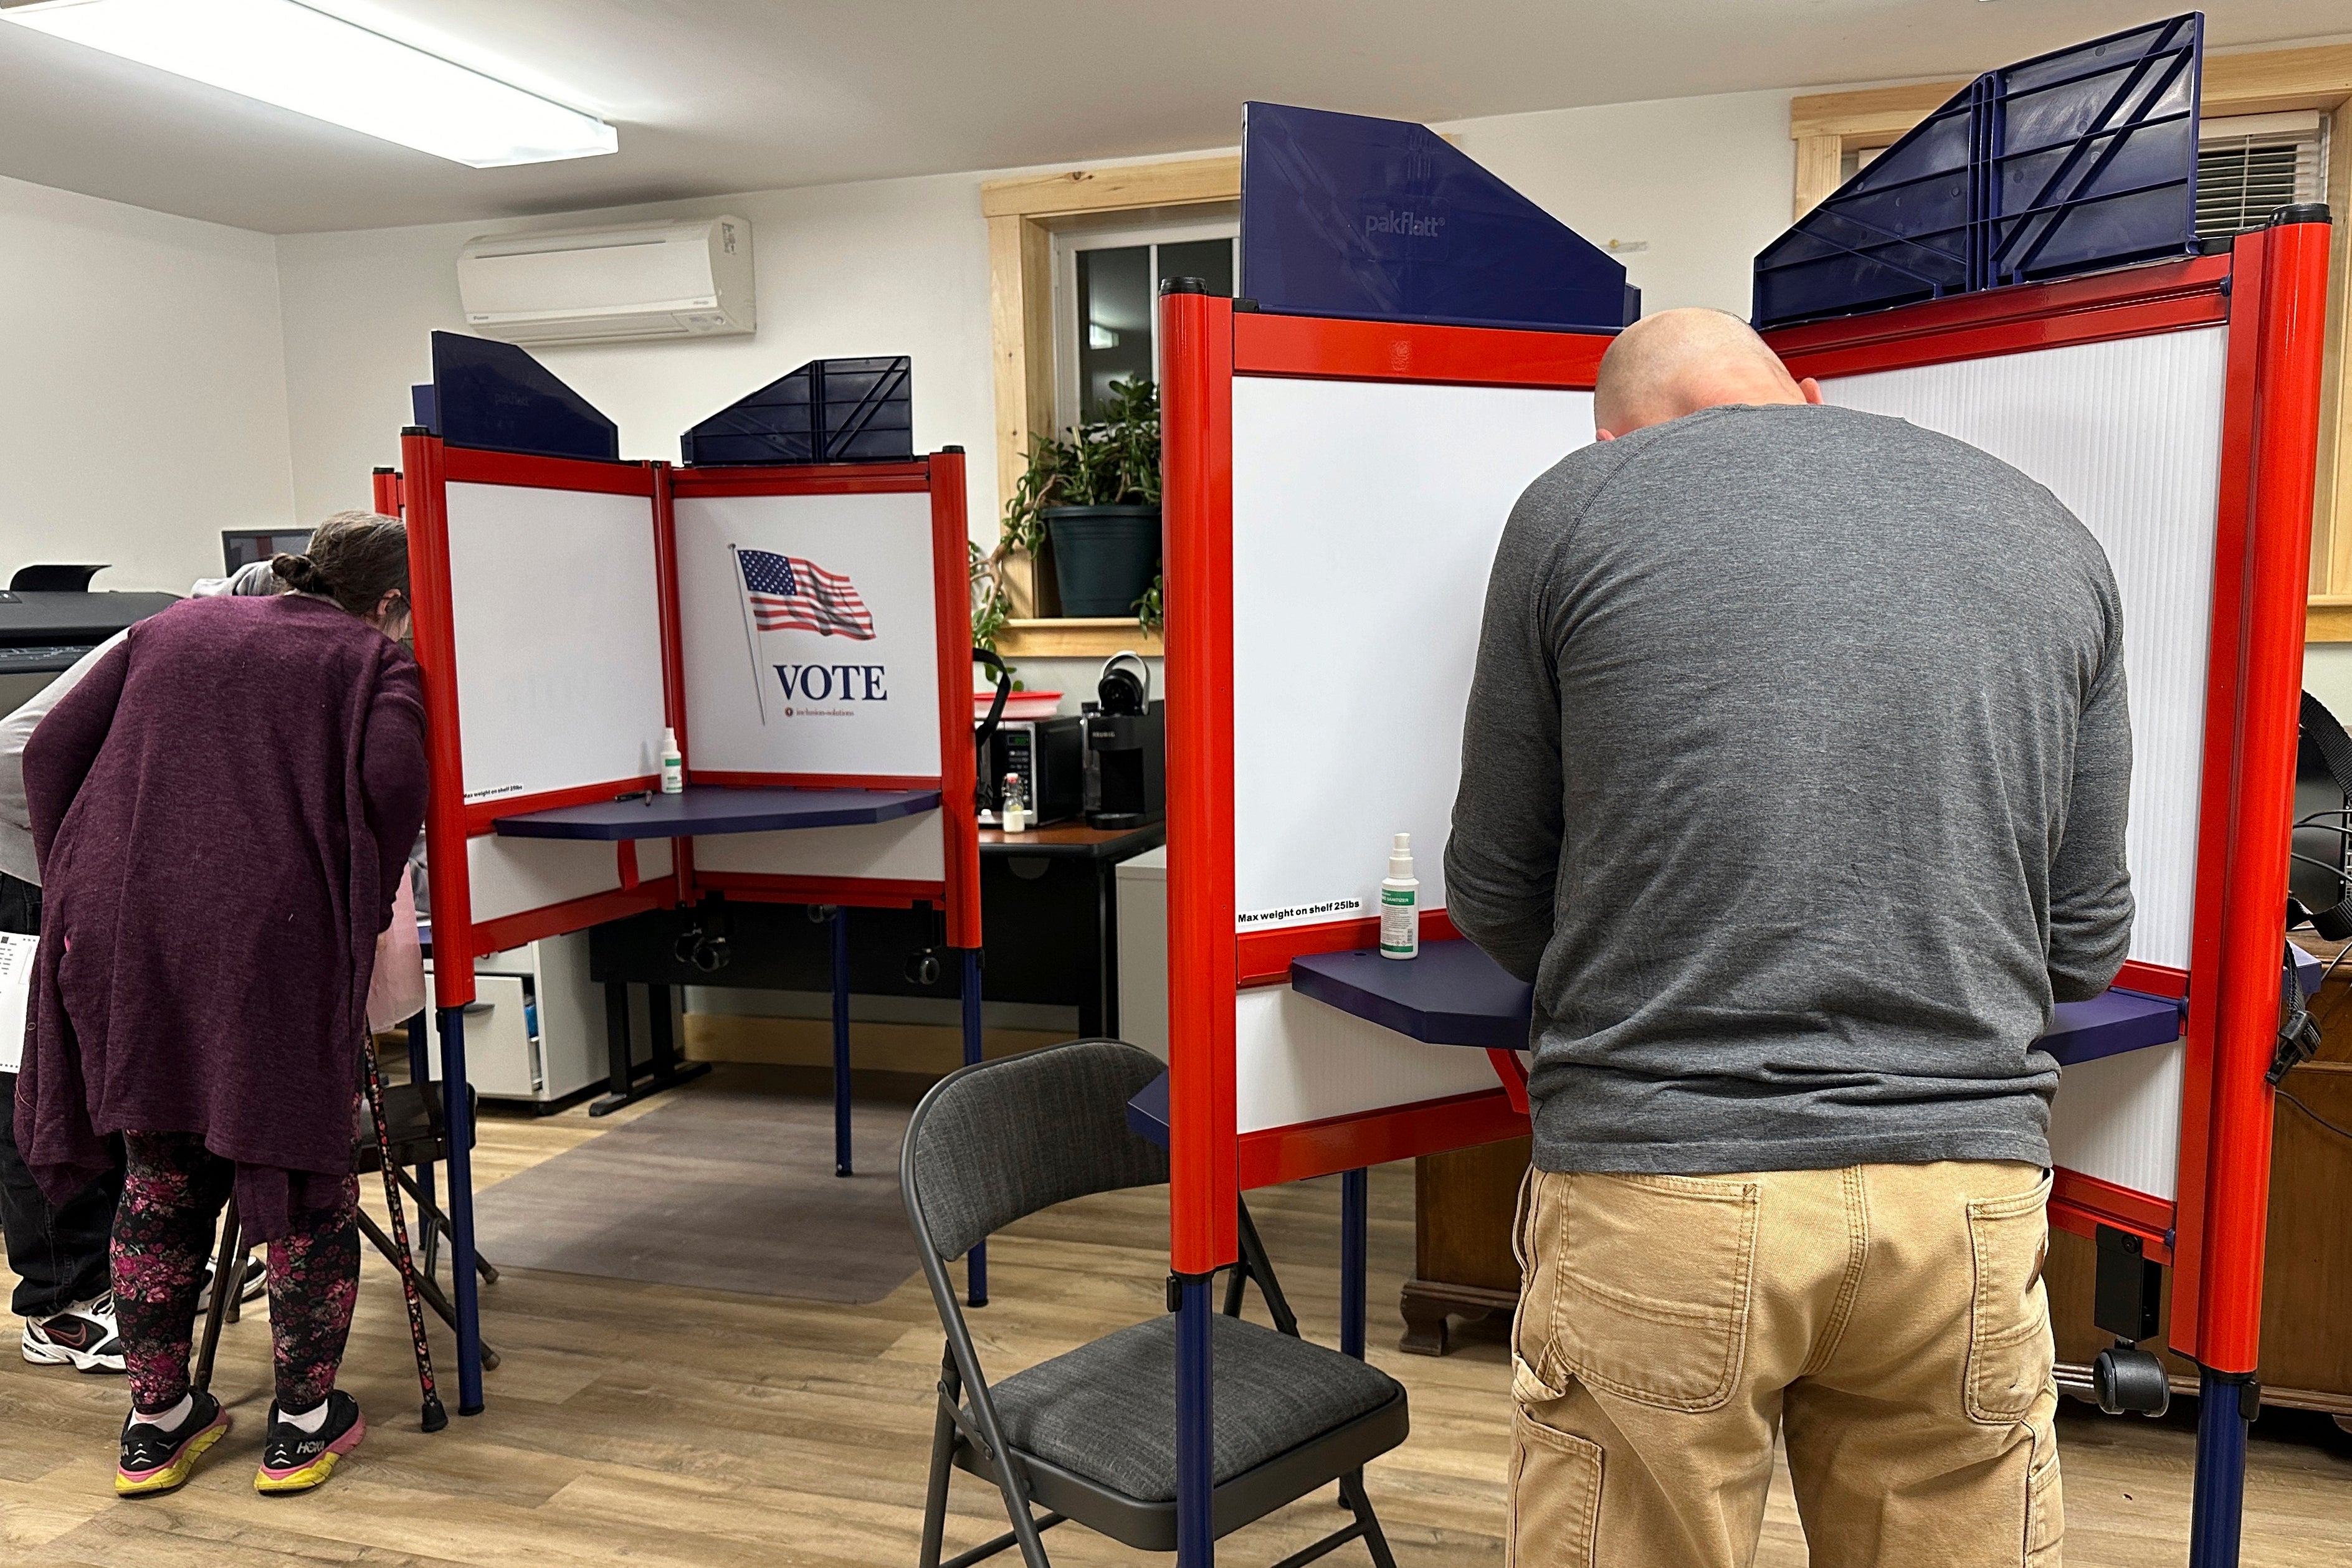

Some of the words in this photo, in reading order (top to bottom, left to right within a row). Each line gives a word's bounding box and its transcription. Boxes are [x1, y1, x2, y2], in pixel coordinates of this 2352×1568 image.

[773, 665, 887, 701] VOTE
[1238, 914, 1259, 923] Max
[1260, 908, 1294, 919] weight
[1295, 908, 1307, 916] on
[1309, 903, 1333, 914] shelf
[1335, 900, 1359, 911] 25lbs
[296, 1440, 325, 1454] HOKA
